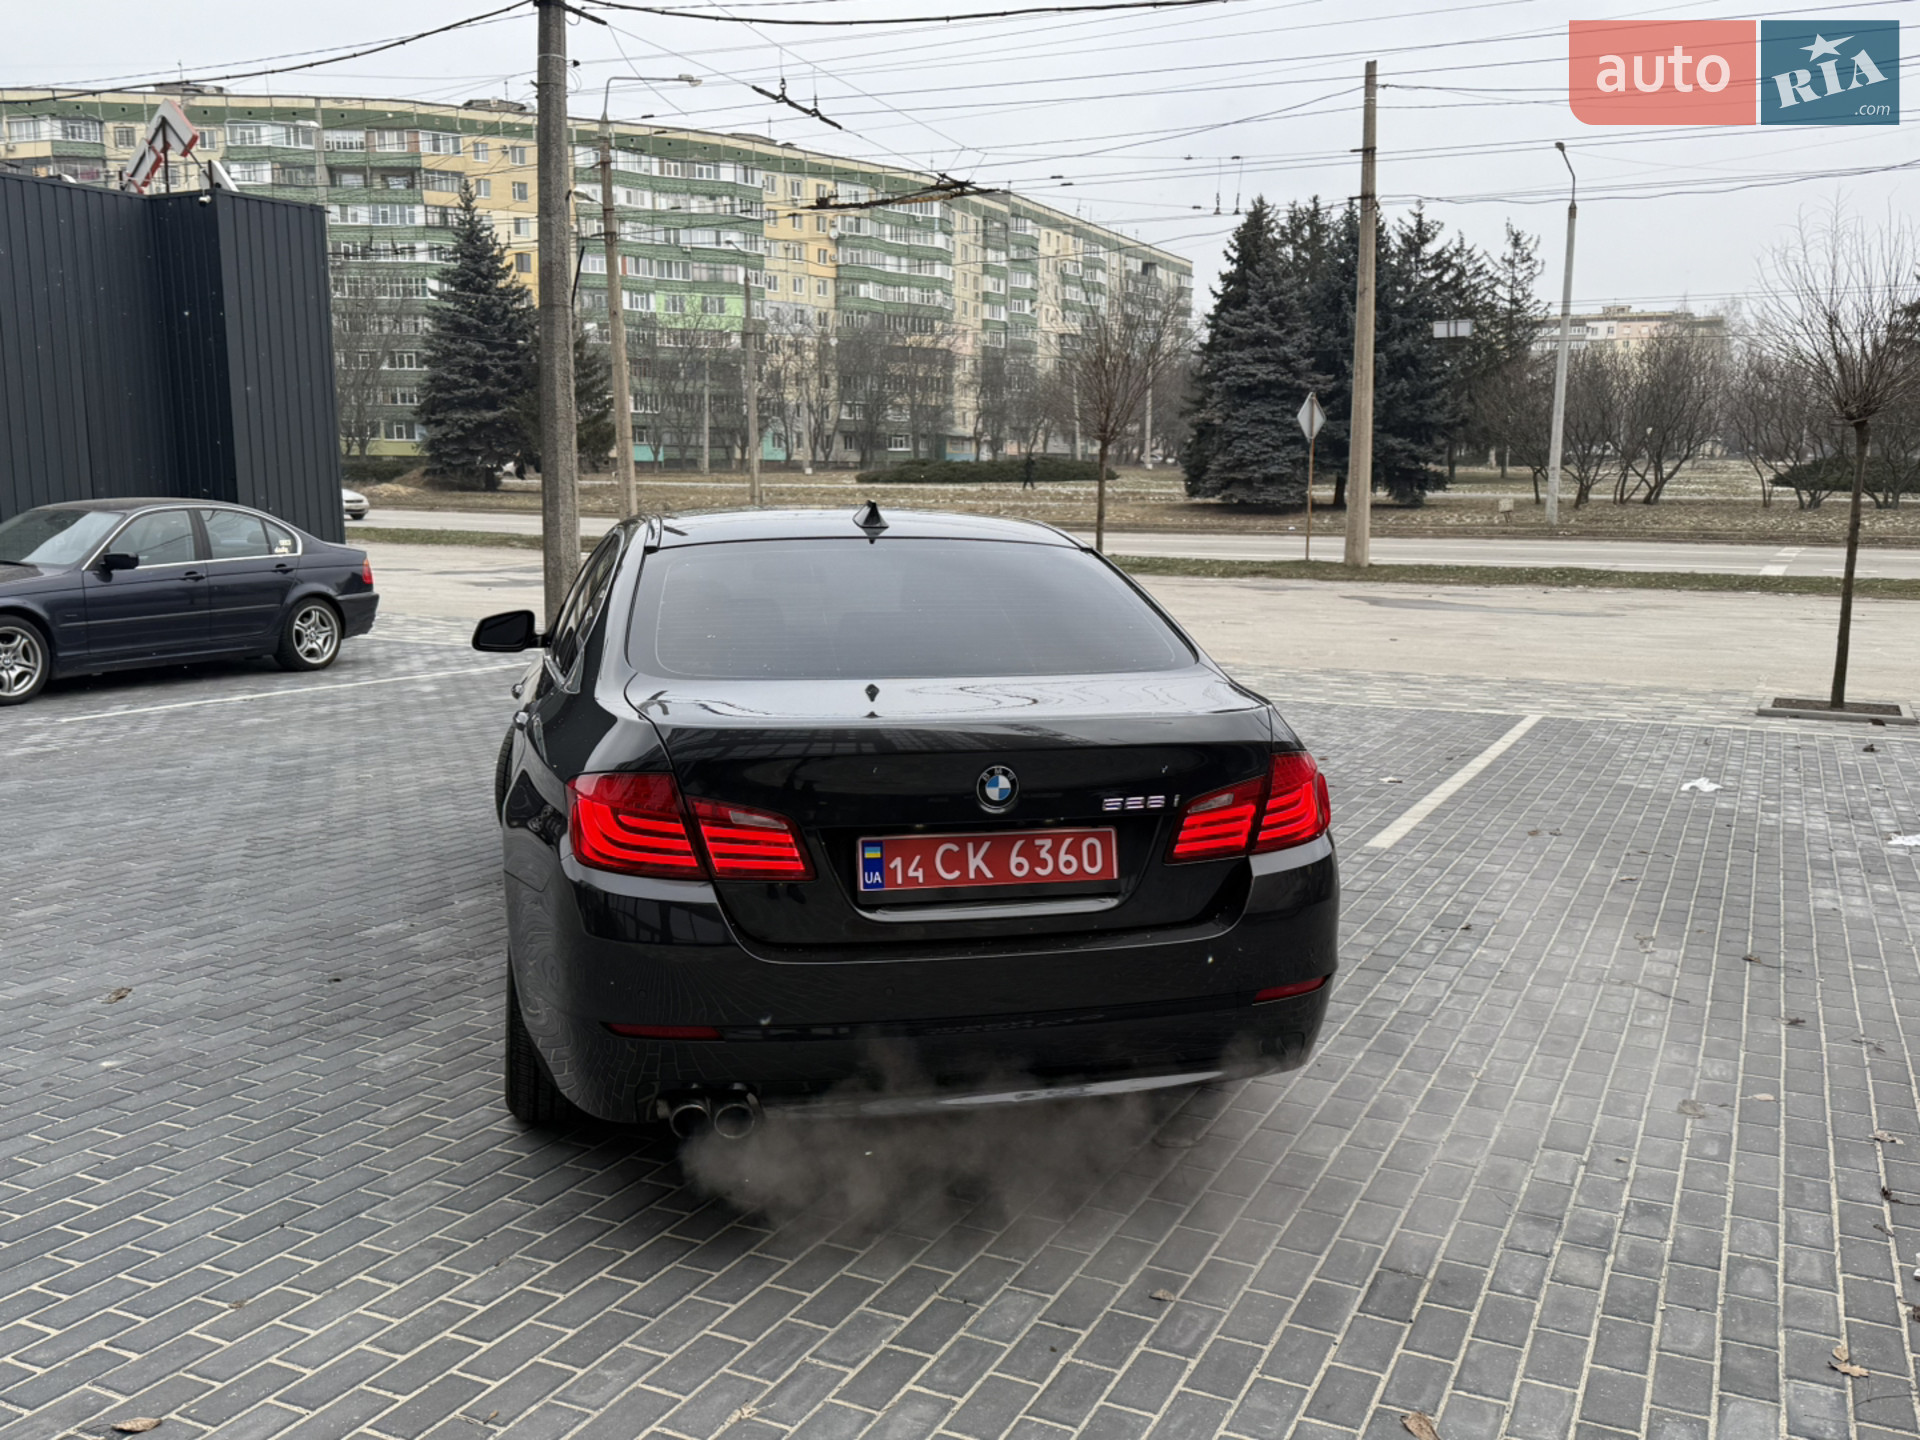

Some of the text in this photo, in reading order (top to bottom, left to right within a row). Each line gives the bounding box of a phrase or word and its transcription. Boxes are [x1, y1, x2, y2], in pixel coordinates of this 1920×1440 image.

[889, 855, 924, 885] 14
[1009, 837, 1103, 878] 6360
[864, 872, 883, 884] UA
